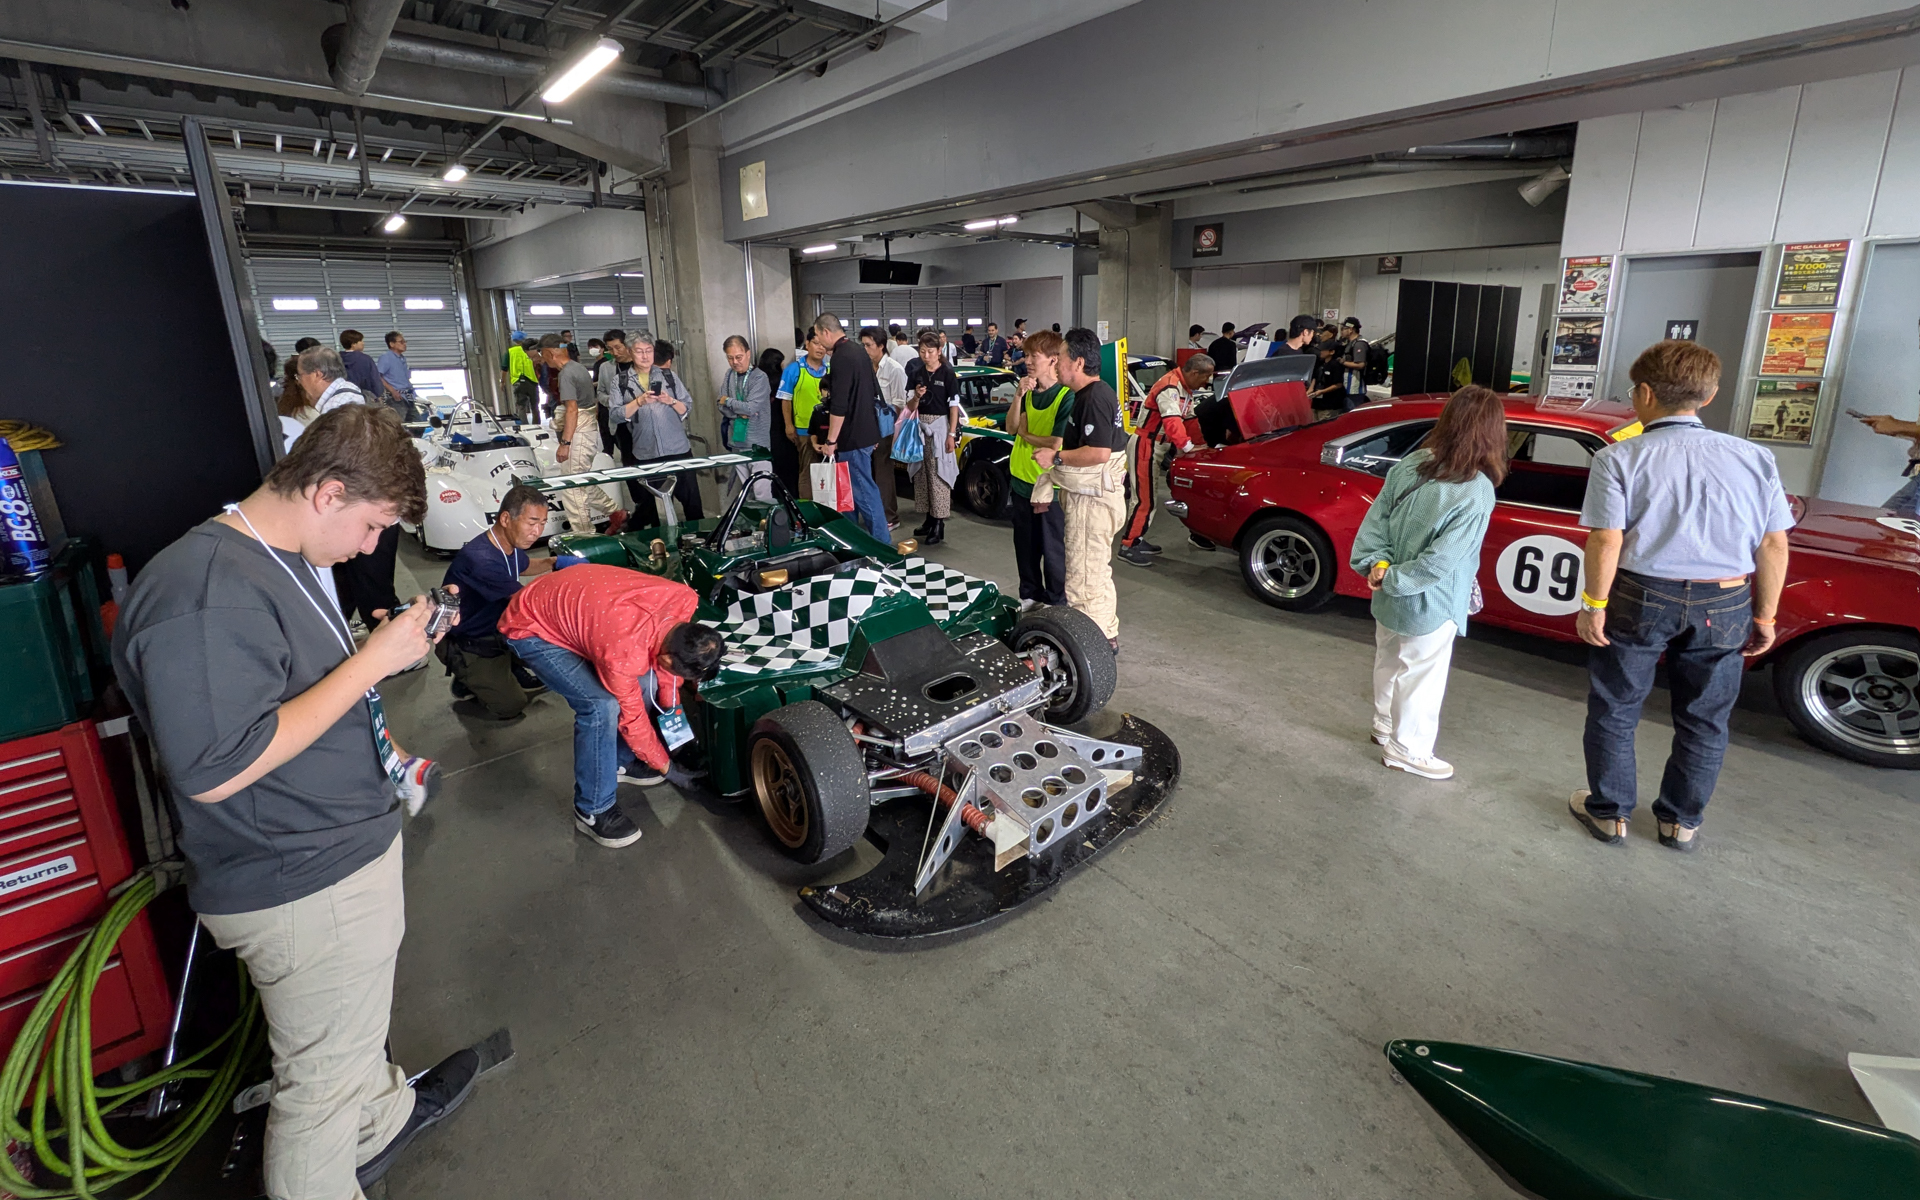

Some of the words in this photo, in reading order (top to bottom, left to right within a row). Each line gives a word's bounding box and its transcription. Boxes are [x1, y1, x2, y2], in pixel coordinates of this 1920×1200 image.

[542, 453, 752, 488] mazda
[0, 499, 37, 541] BC-8
[1513, 546, 1580, 602] 69
